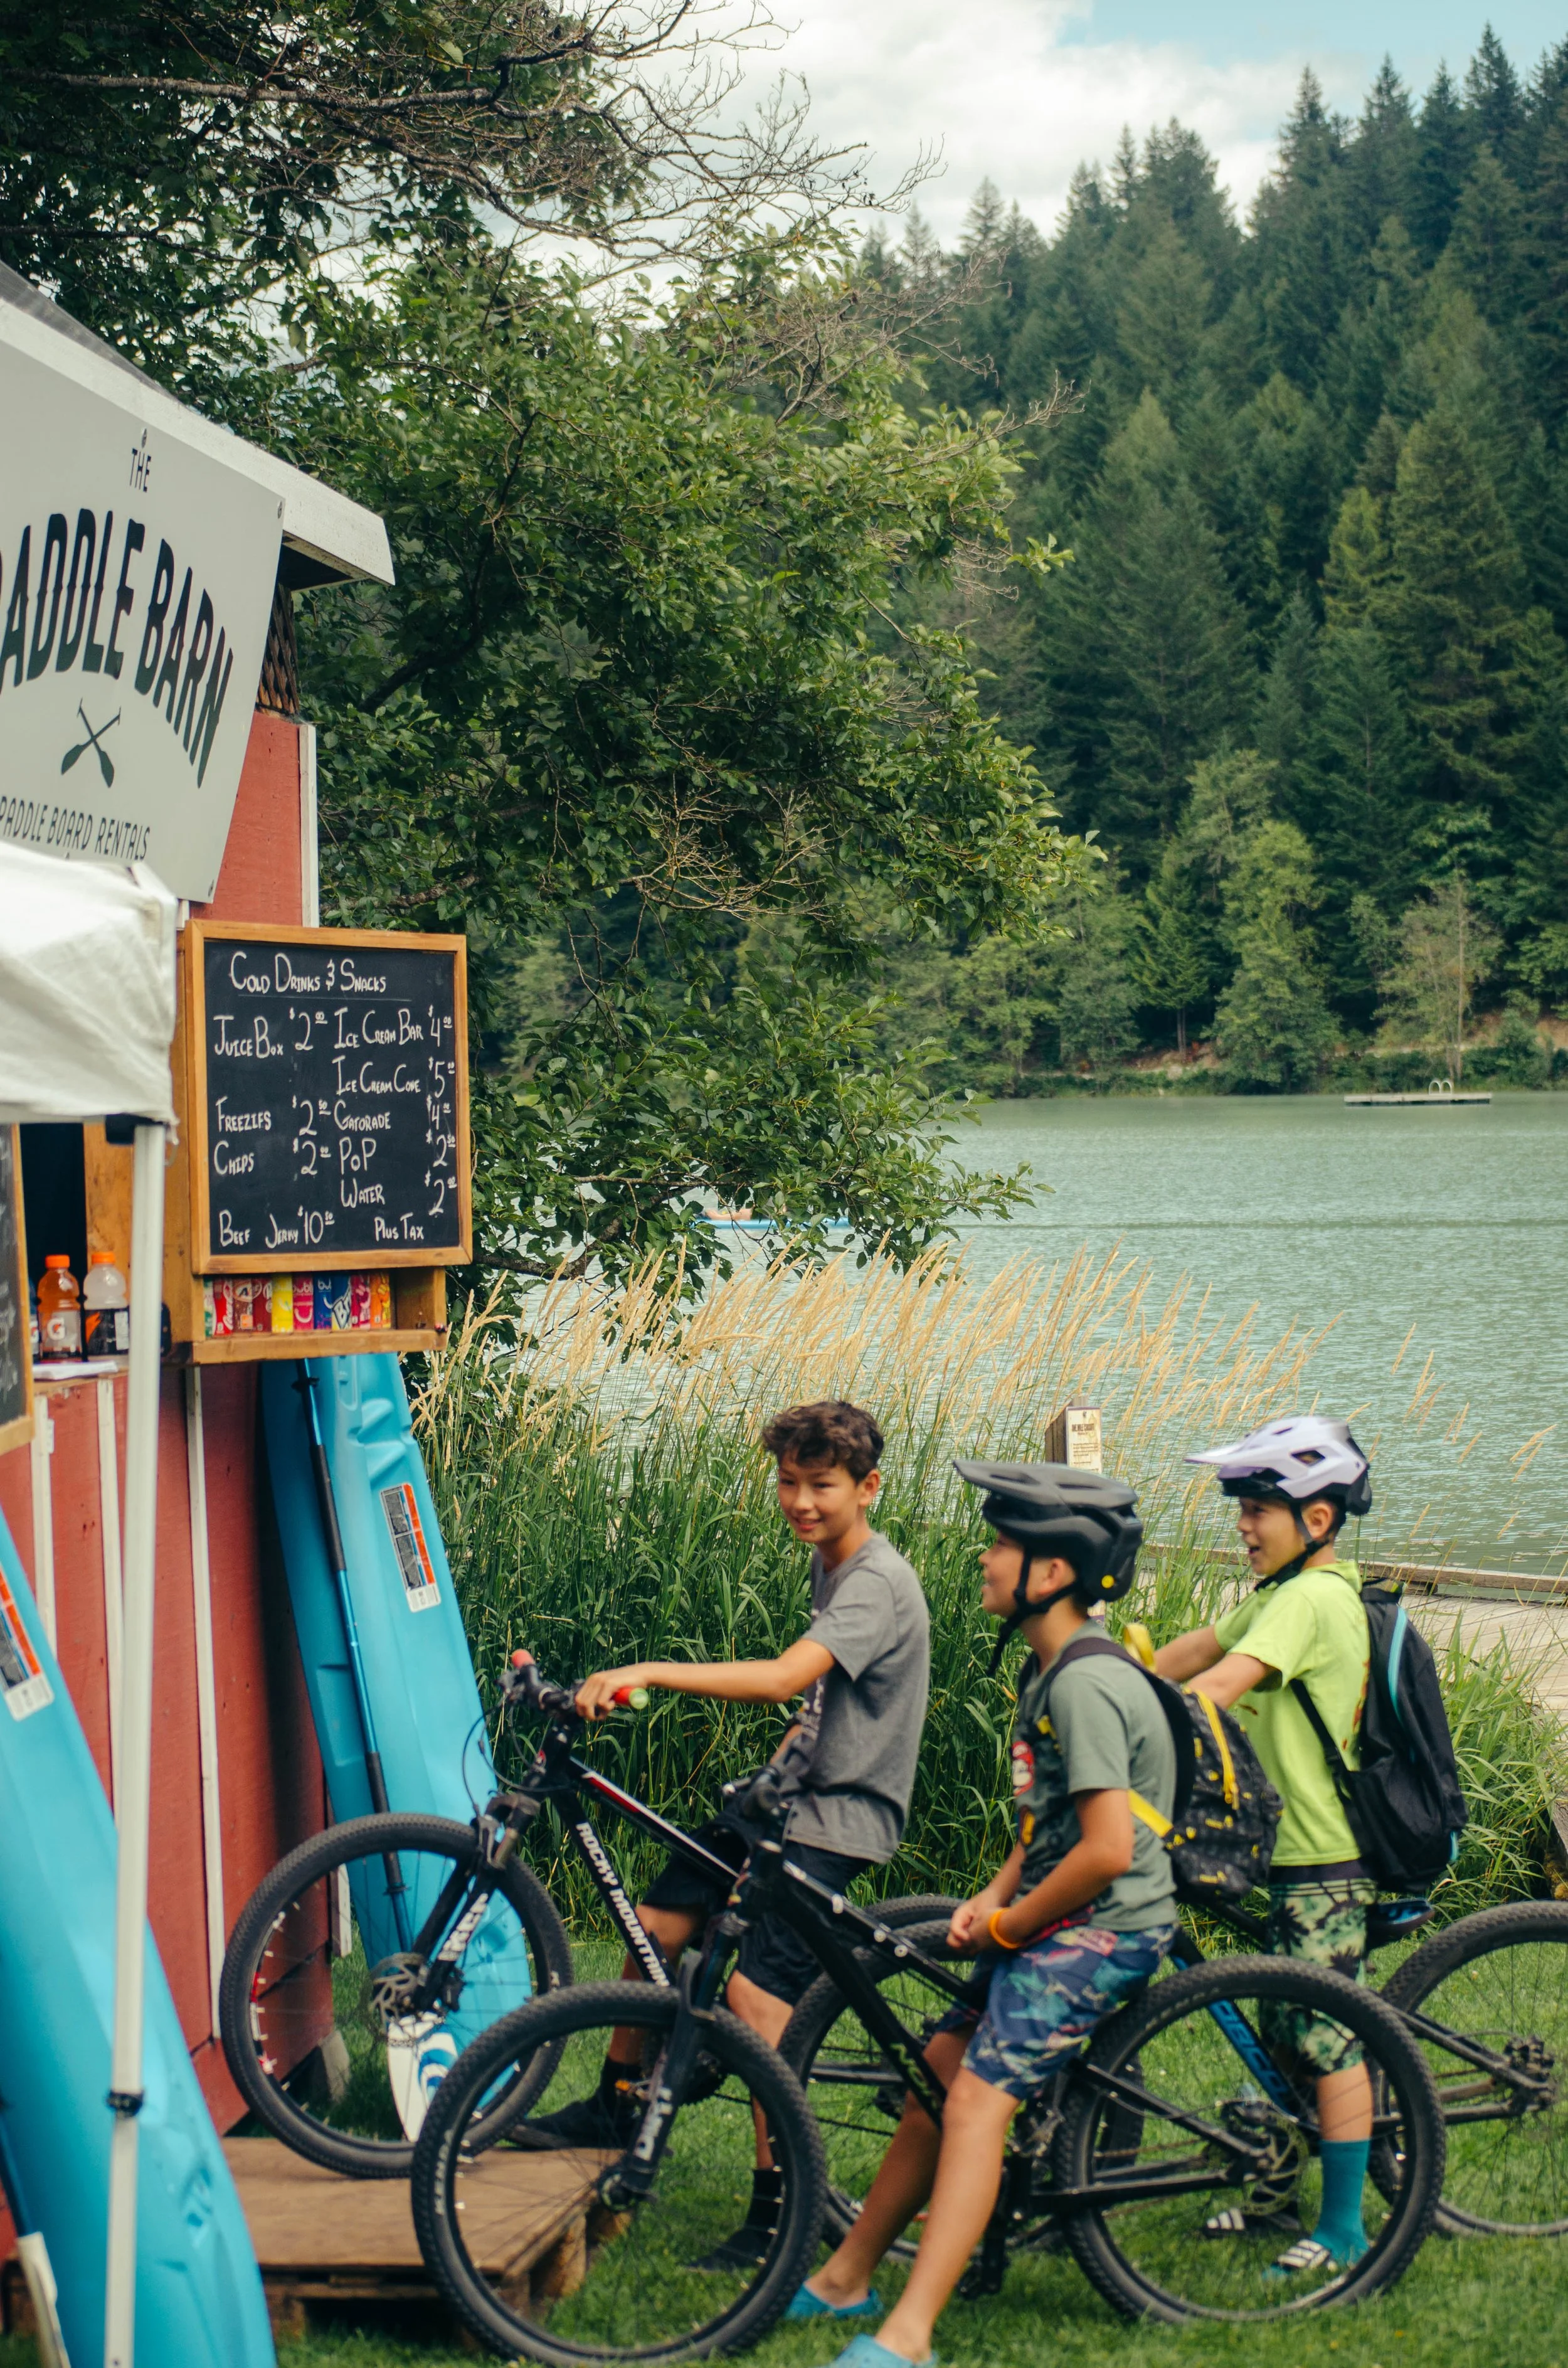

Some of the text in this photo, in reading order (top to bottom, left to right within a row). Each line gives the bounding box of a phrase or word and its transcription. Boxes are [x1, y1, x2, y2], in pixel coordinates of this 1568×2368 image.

[130, 448, 152, 492] THE
[0, 507, 233, 789] ADDLE BARN
[0, 795, 151, 860] PADDLE BOARD RENTALS
[576, 1822, 670, 1987] ROCKY MOUNTAIN
